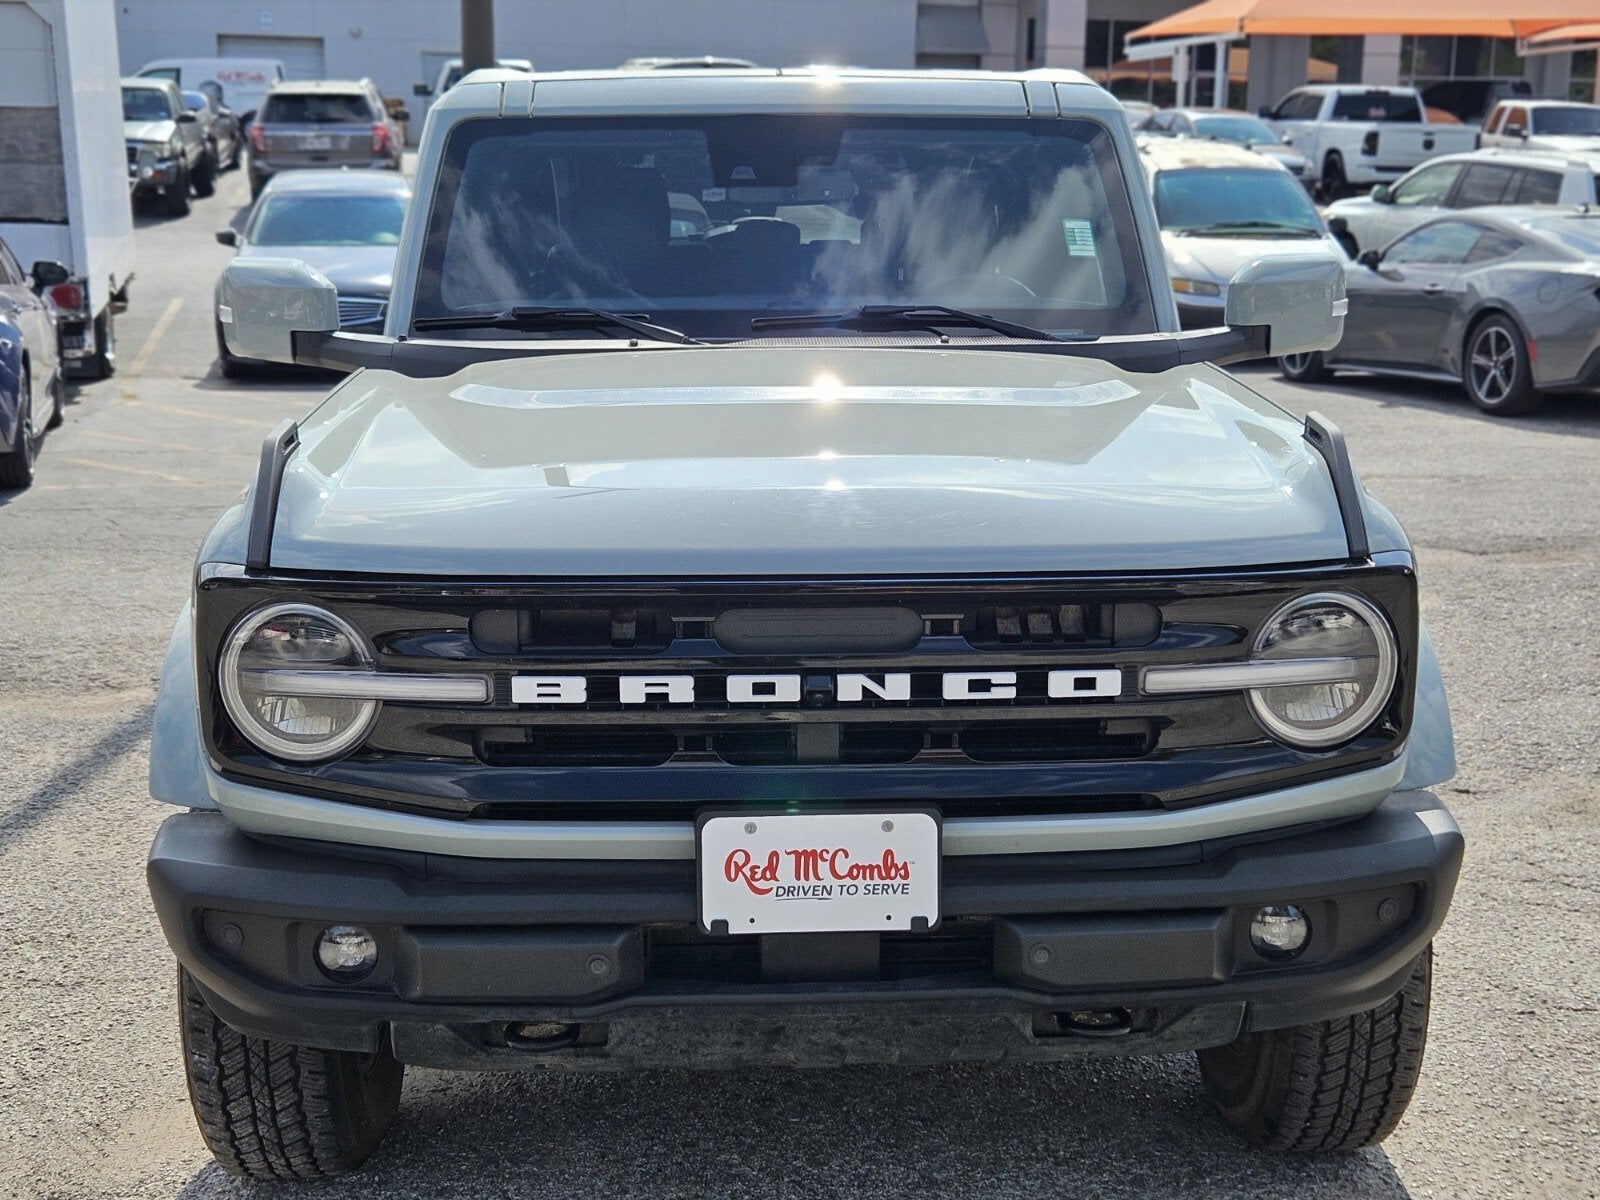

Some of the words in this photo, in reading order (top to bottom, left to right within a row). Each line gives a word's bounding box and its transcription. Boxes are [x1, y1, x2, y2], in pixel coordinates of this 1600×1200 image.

[510, 669, 1123, 705] BRONCO
[724, 848, 781, 896] Red
[785, 847, 910, 882] McCombs
[775, 885, 833, 898] DRIVEN
[838, 884, 858, 896] TO
[863, 883, 910, 896] SERVE
